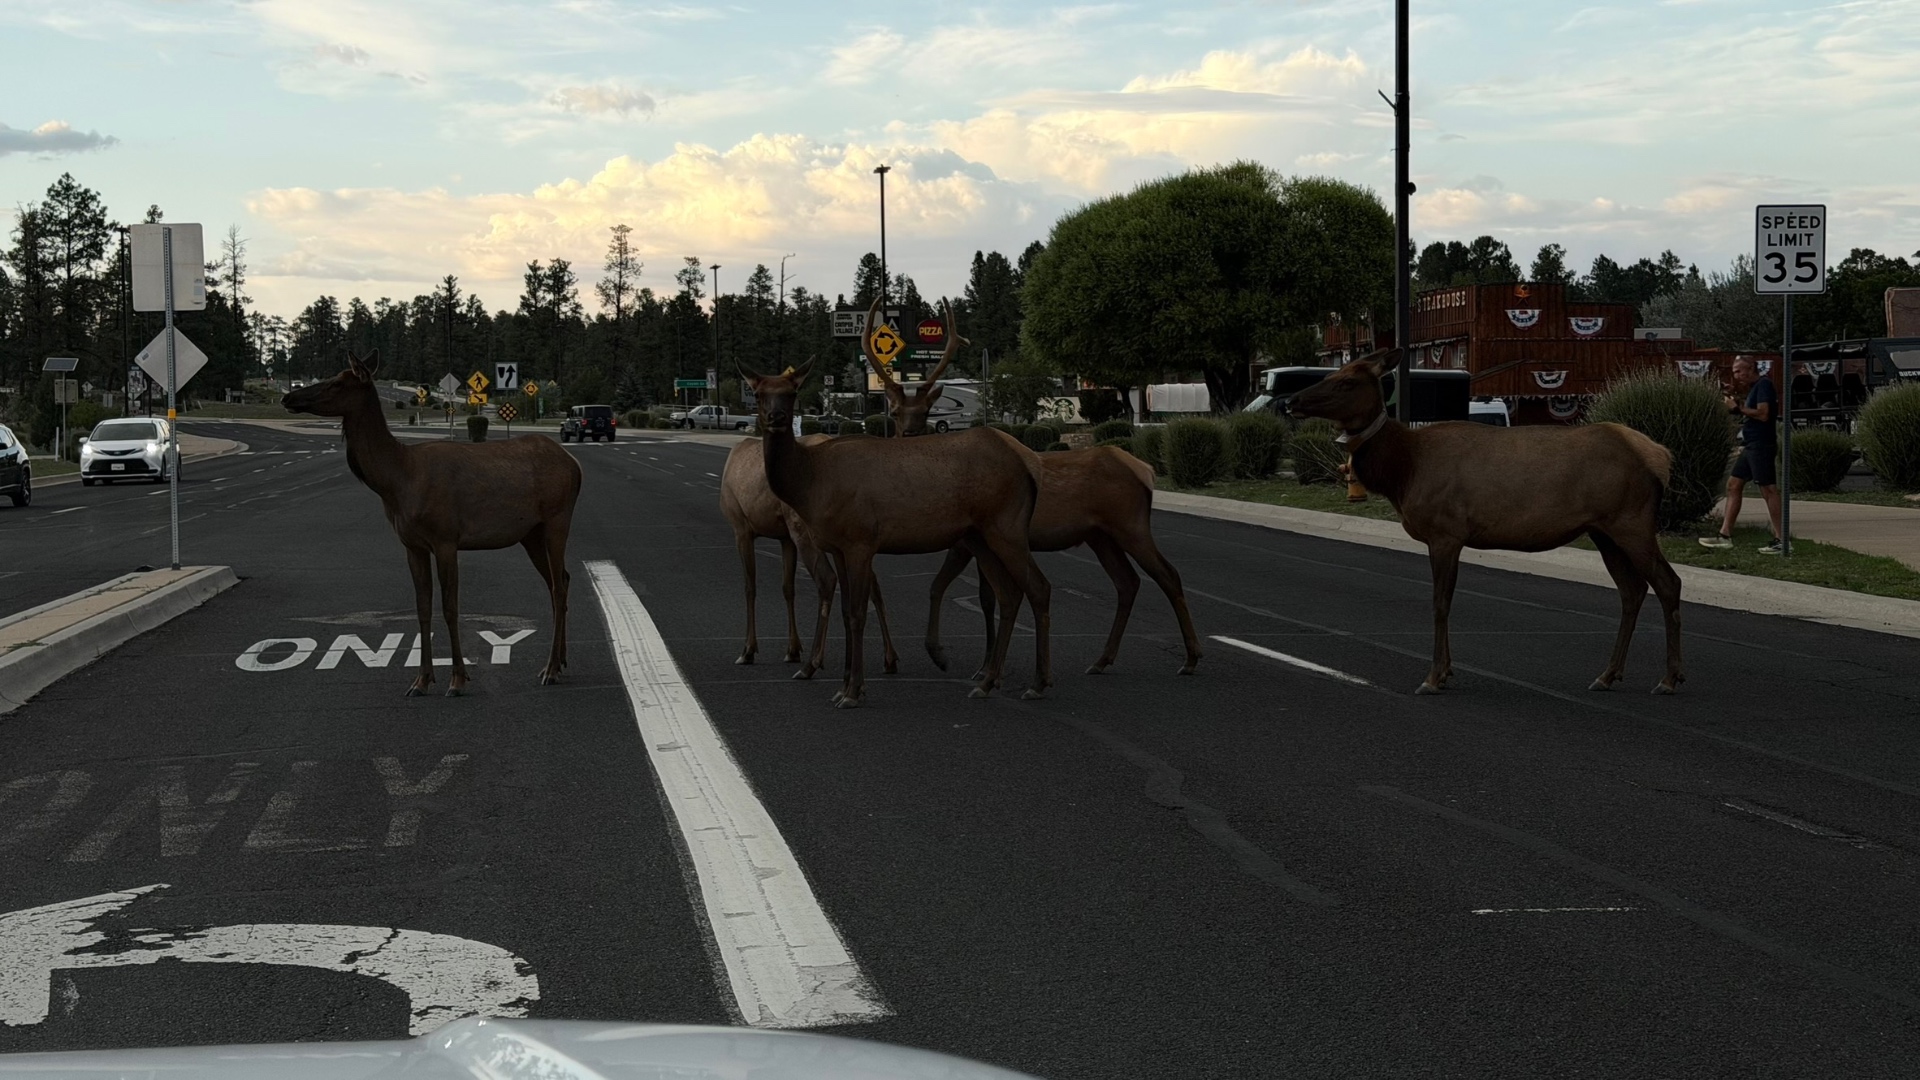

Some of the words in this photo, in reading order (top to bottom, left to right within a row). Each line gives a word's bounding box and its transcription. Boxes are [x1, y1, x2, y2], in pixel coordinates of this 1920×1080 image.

[1762, 215, 1821, 229] SPEED
[1767, 233, 1814, 247] LIMIT
[1763, 251, 1819, 284] 35
[1417, 290, 1466, 313] STEAKHOUSE
[919, 326, 944, 336] PIZZA
[235, 629, 538, 672] ONLY
